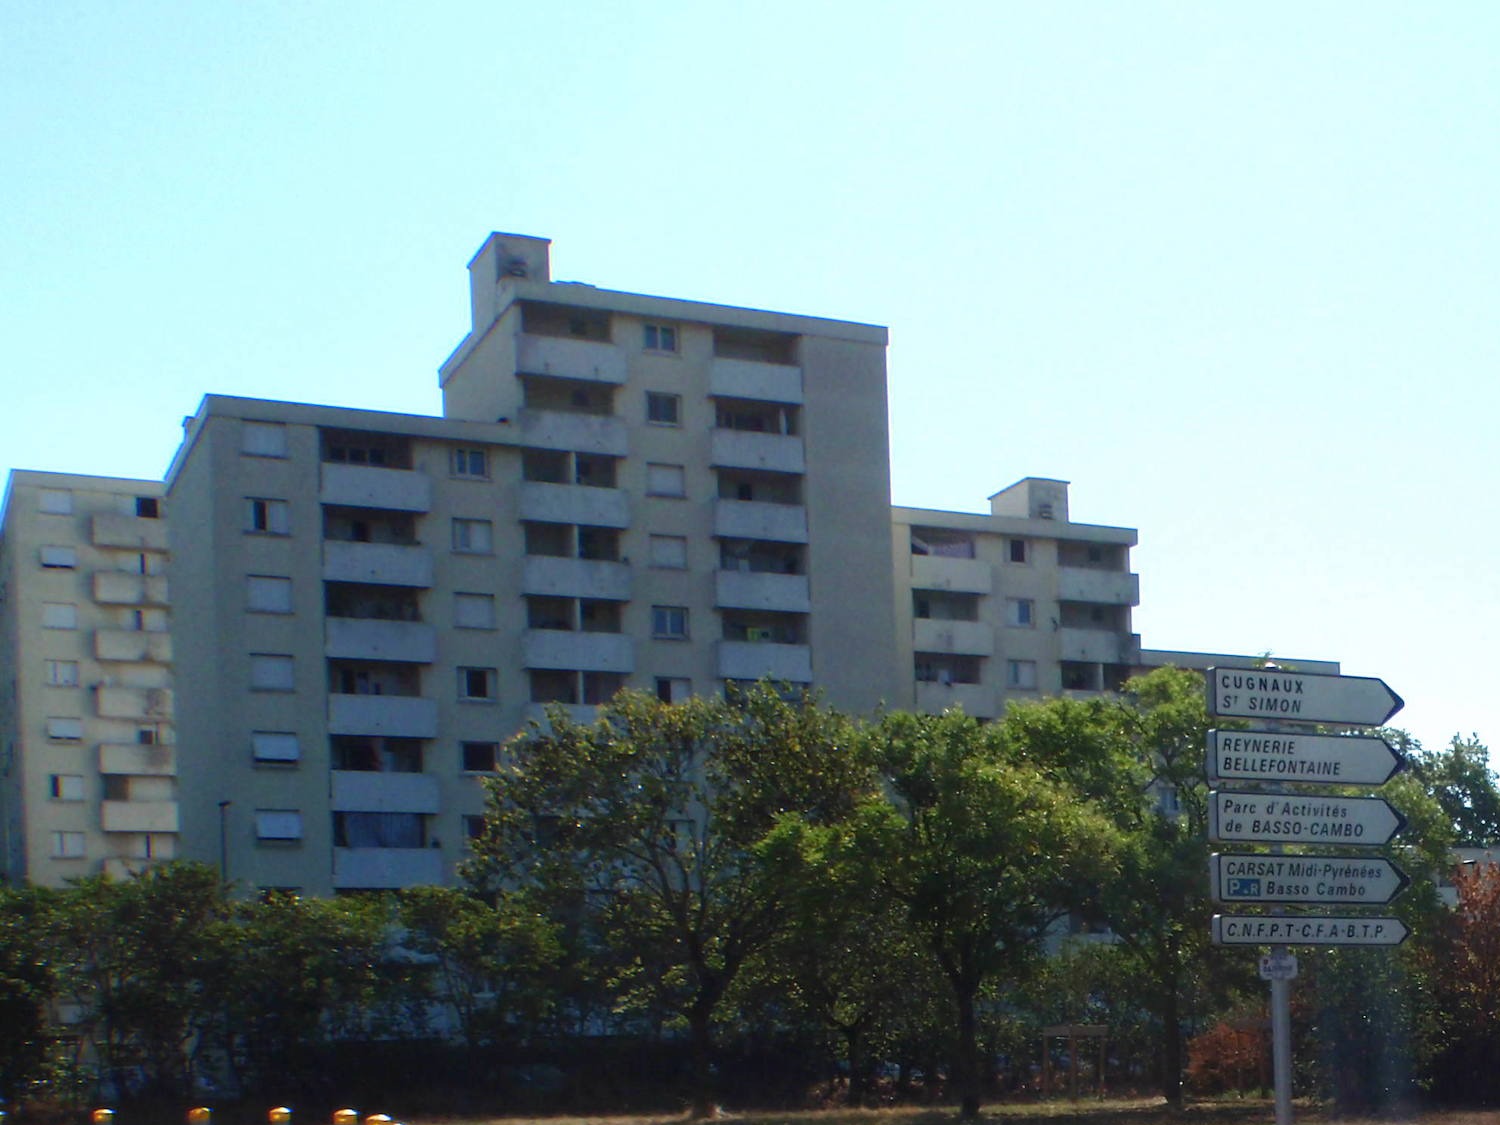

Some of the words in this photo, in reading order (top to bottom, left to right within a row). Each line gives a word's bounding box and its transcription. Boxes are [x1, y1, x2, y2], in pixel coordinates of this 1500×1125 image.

[1222, 675, 1304, 694] CUGNAUX
[1249, 696, 1302, 713] SIMON
[1223, 737, 1295, 755] REYNERIE
[1224, 757, 1341, 776] BELLEFONTAINE
[1224, 800, 1256, 814] Parc
[1225, 819, 1242, 833] de
[1252, 820, 1363, 837] BASSO-CAMBO
[1227, 862, 1284, 876] CARSAT
[1288, 863, 1382, 880] Midi-Pyrénées
[1267, 883, 1309, 895] Basso
[1317, 883, 1365, 896] Cambo
